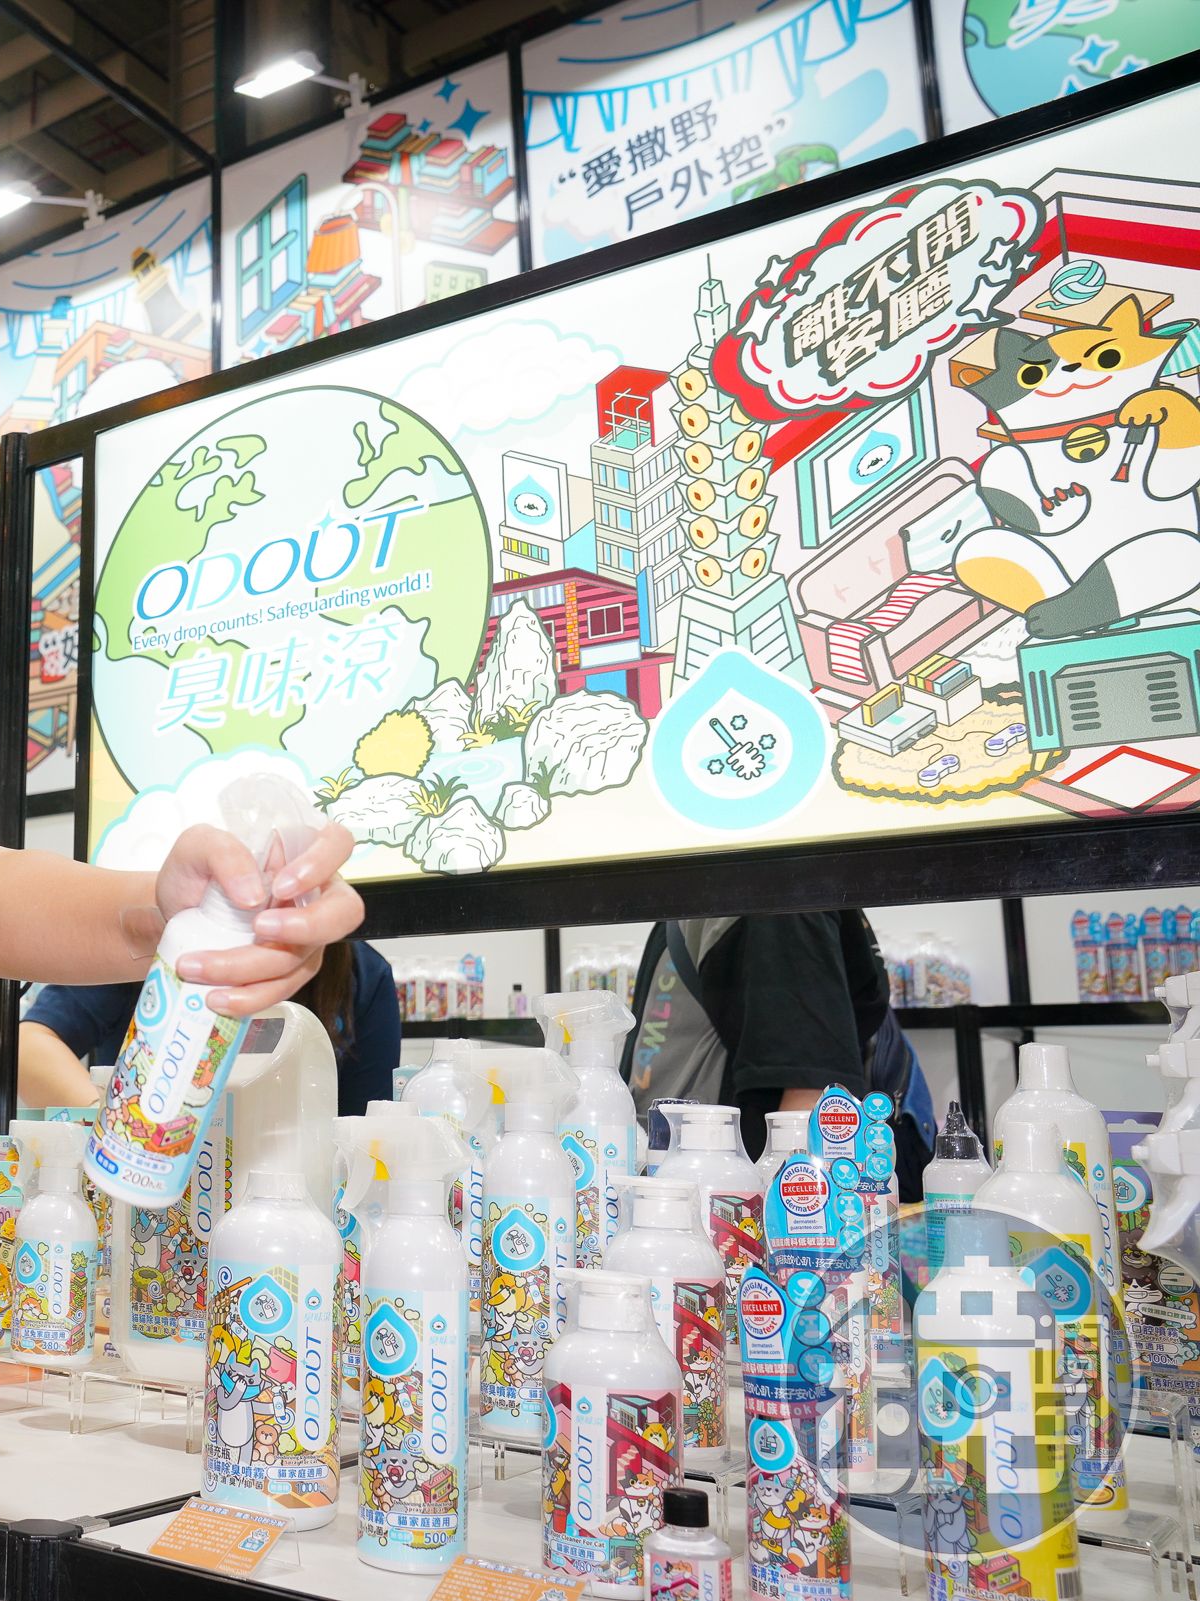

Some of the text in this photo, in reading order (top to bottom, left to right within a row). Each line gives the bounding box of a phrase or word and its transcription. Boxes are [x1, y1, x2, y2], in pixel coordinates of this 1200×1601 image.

[788, 192, 980, 364] 離不開
[137, 505, 424, 620] ODOUT
[133, 633, 172, 651] Every
[174, 624, 208, 643] drop
[210, 609, 264, 634] counts!
[267, 590, 370, 622] Safeguarding
[373, 575, 422, 598] world
[157, 617, 401, 731] 臭味滾
[148, 1026, 192, 1116] ODOUT
[821, 1098, 852, 1112] ORIGINAL
[820, 1115, 855, 1123] EXCELLENT
[821, 1127, 853, 1140] dermatest
[784, 1166, 818, 1181] ORIGINAL
[784, 1185, 824, 1194] EXCELLENT
[785, 1199, 820, 1213] dermatest
[743, 1283, 773, 1297] ORIGINAL
[743, 1304, 779, 1312] EXCELLENT
[303, 1326, 322, 1441] ODOUT
[431, 1348, 449, 1455] ODOUT
[277, 1467, 323, 1479] 貓家庭適用
[576, 1426, 594, 1522] ODOUT
[993, 1416, 1024, 1541] ODOUT
[397, 1515, 451, 1528] 貓家庭適用
[556, 1542, 595, 1560] 貓家庭適用
[952, 1582, 977, 1597] Urine
[979, 1588, 1005, 1601] Stain
